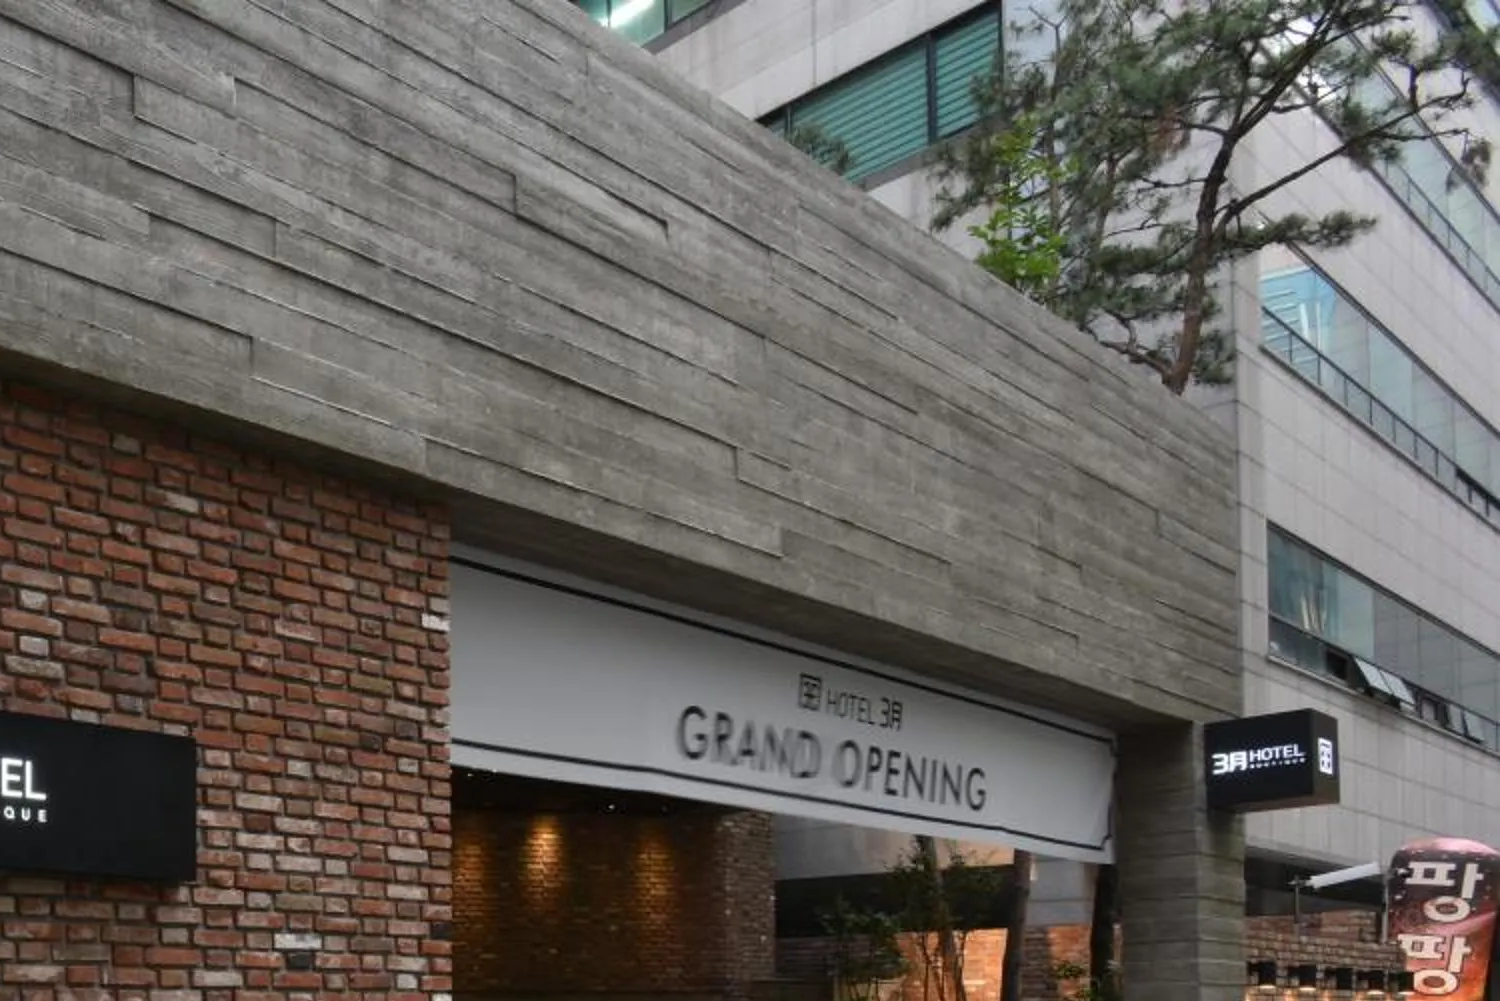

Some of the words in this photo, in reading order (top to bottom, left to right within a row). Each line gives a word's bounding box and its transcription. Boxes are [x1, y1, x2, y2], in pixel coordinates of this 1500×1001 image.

[825, 688, 876, 727] HOTEL
[677, 705, 822, 778] GRAND
[832, 739, 987, 811] OPENING
[1249, 743, 1305, 763] HOTEL
